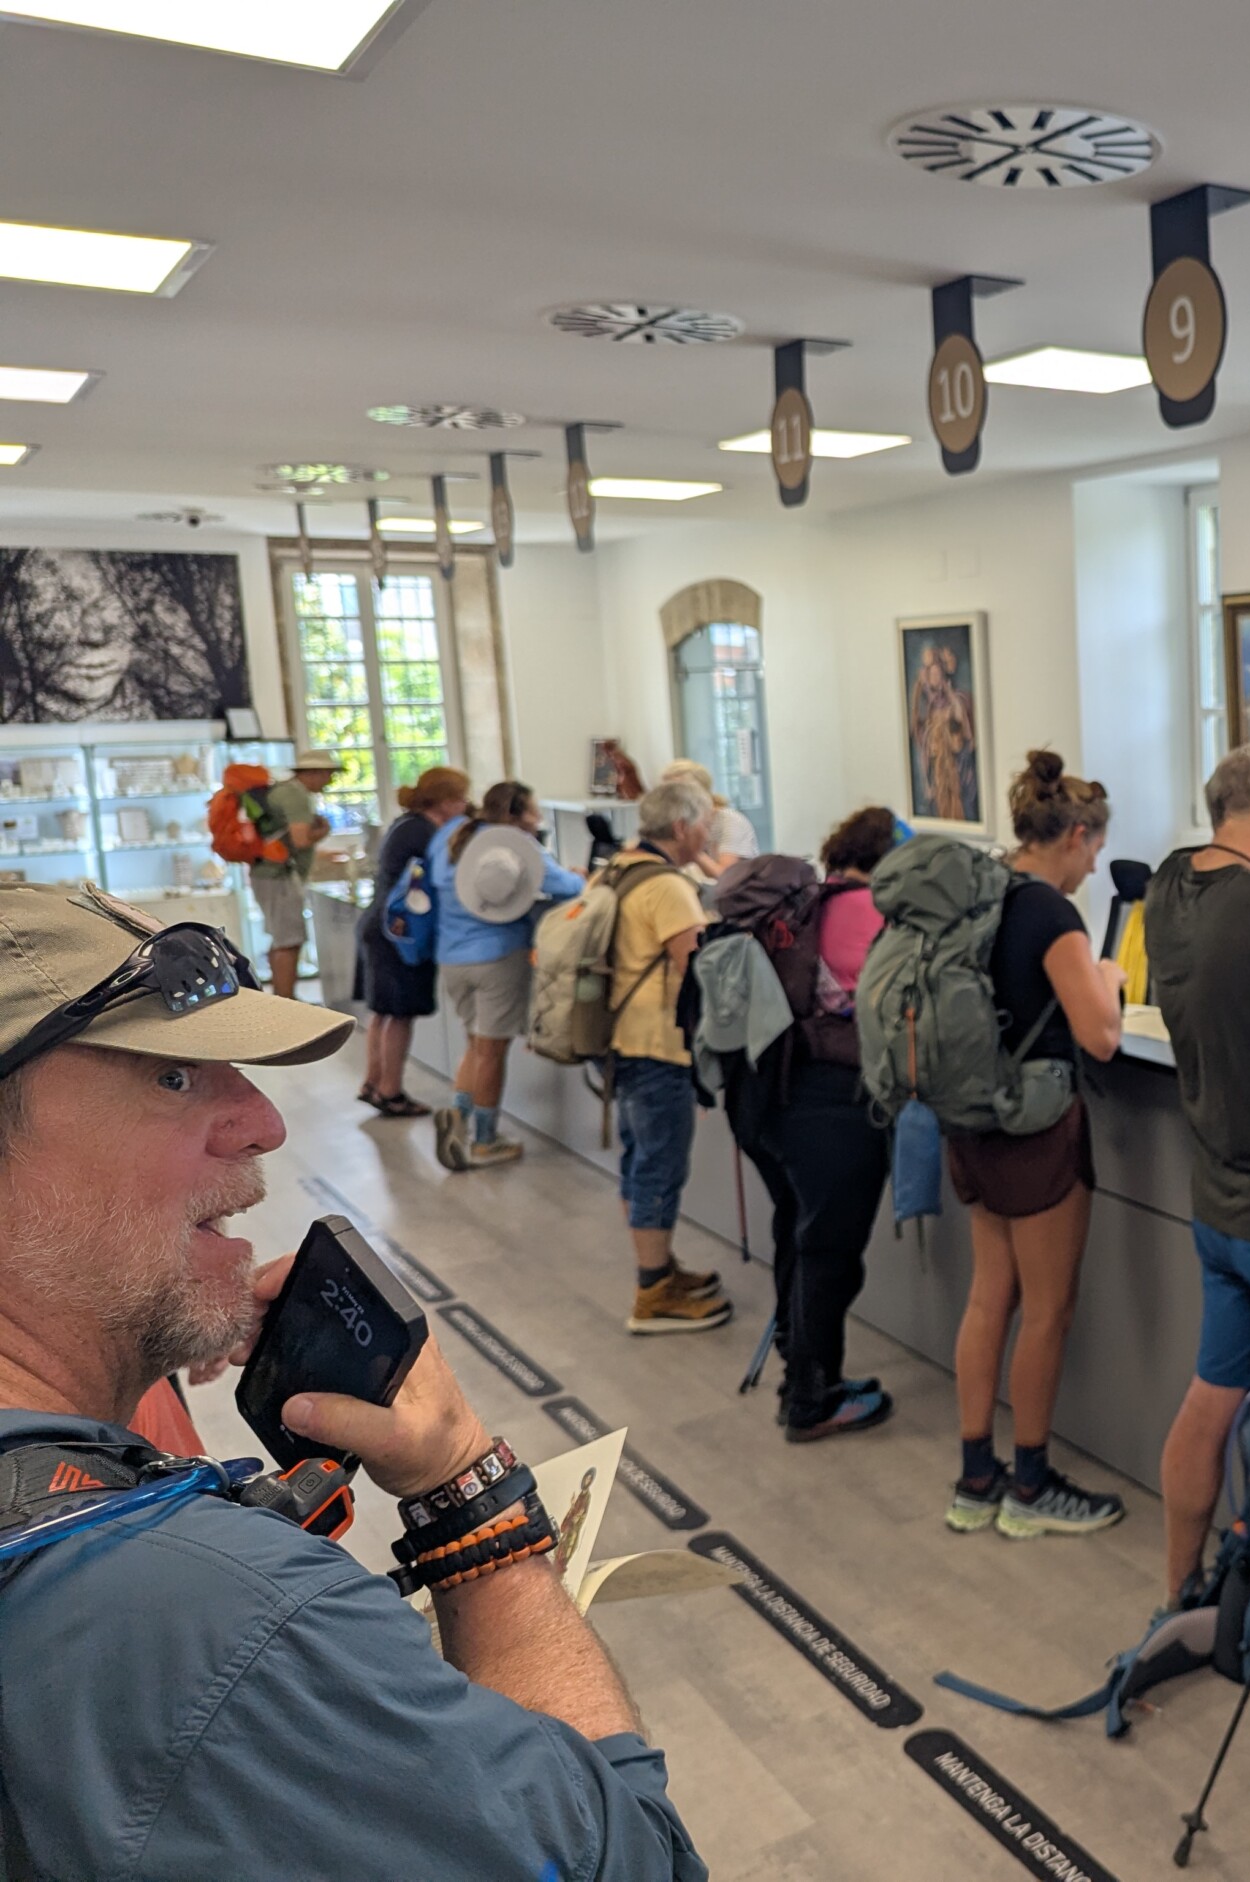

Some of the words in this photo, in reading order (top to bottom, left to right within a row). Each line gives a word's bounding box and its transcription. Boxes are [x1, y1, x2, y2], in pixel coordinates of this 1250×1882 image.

[1169, 296, 1196, 364] 9
[937, 362, 975, 424] 10
[777, 414, 805, 465] 11
[320, 1279, 373, 1347] 2:40
[764, 1596, 821, 1642] DISTANCIA
[808, 1637, 838, 1659] DE
[823, 1651, 892, 1711] SEGURIDAD
[933, 1750, 1013, 1824] MANTENGA
[1001, 1812, 1032, 1841] LA
